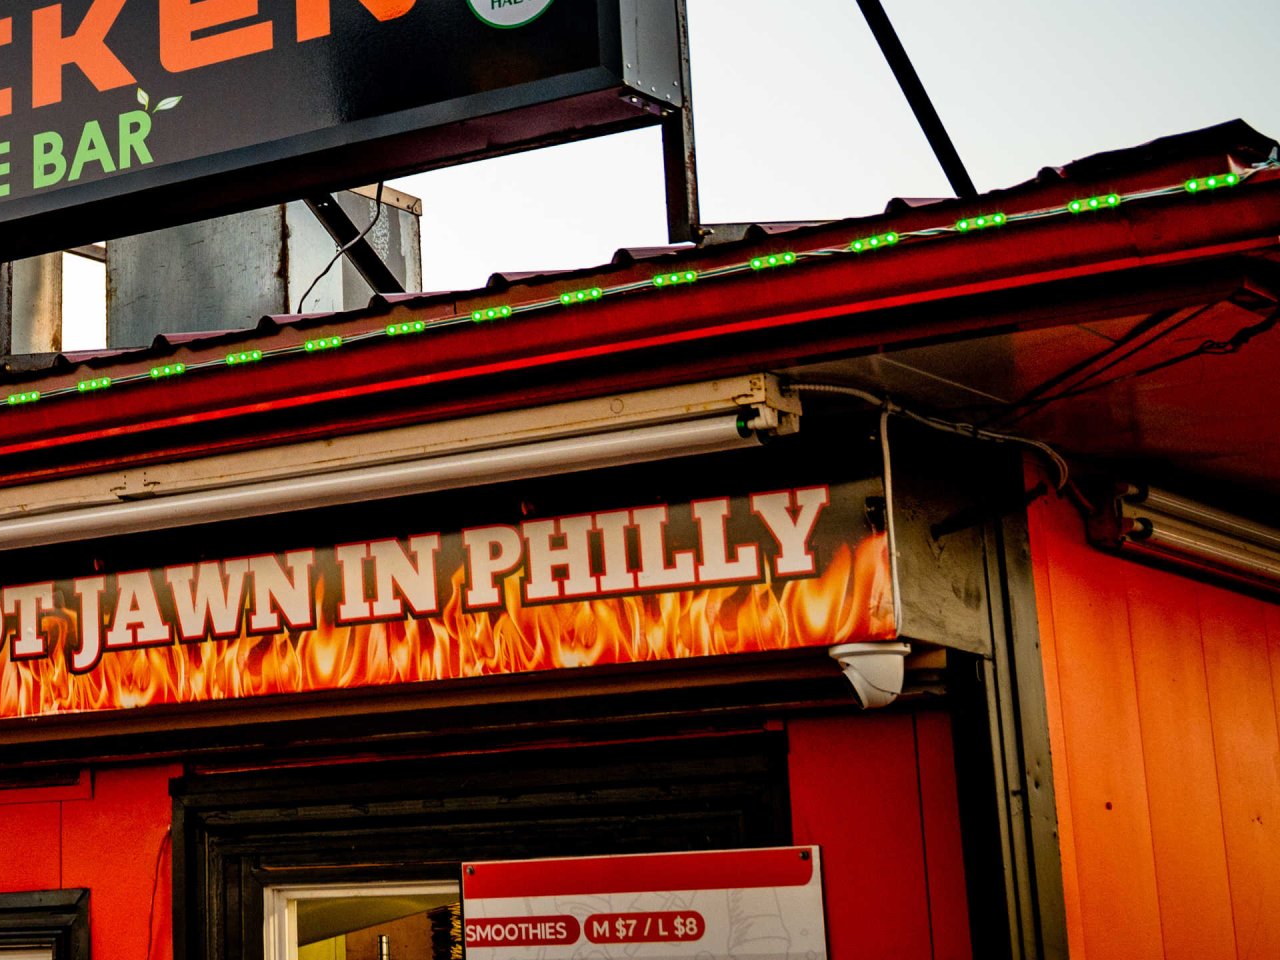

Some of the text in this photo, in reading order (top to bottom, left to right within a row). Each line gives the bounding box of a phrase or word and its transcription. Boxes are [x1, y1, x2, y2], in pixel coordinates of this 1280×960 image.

[33, 109, 154, 190] BAR
[73, 548, 317, 672] JAWN
[337, 533, 440, 626] IN
[464, 485, 830, 607] PHILLY
[466, 921, 567, 942] SMOOTHIES
[592, 921, 610, 938] M
[615, 918, 637, 939] $7
[658, 920, 668, 937] L
[674, 916, 698, 938] $8
